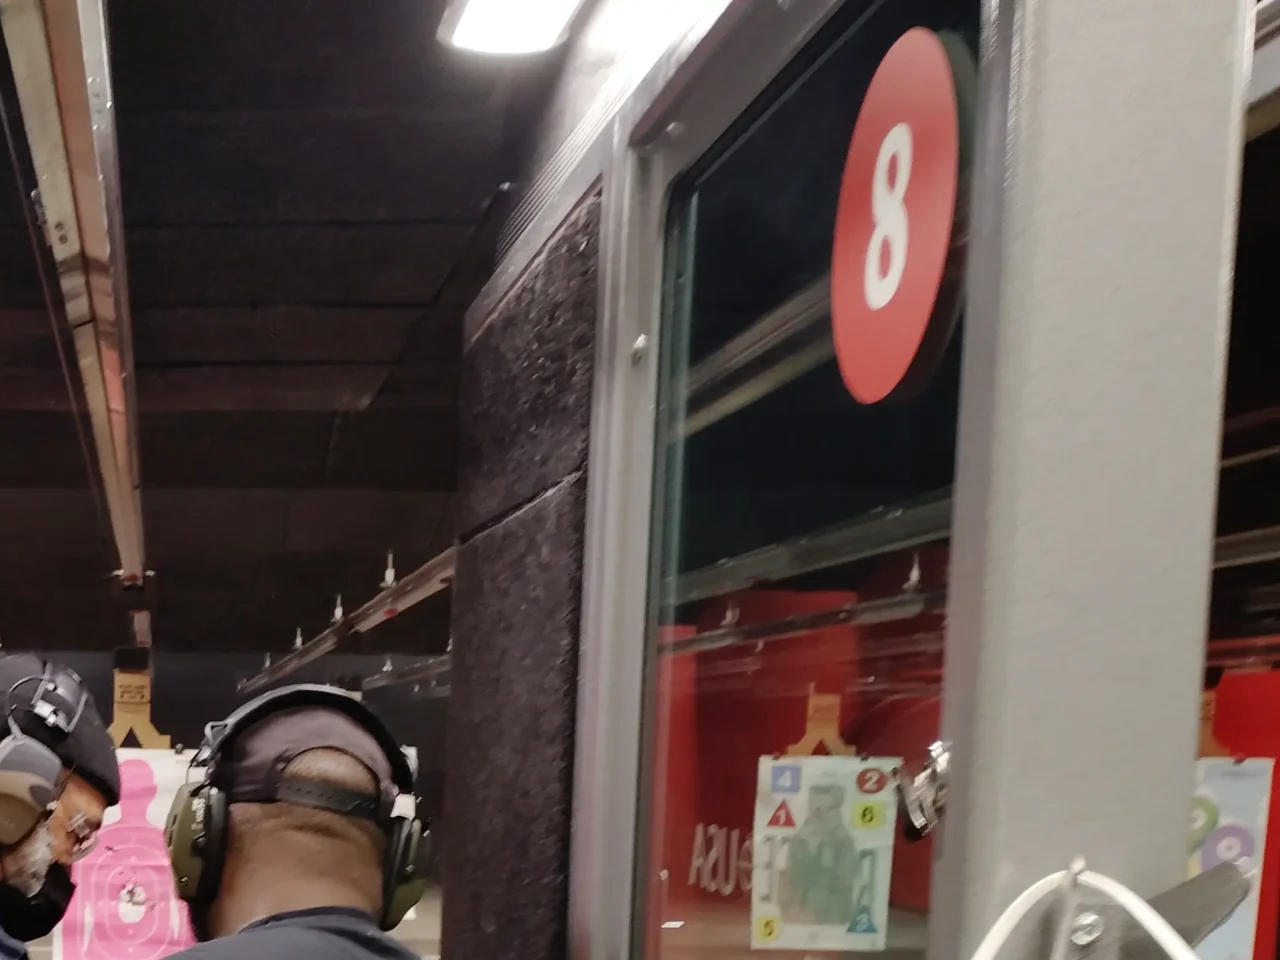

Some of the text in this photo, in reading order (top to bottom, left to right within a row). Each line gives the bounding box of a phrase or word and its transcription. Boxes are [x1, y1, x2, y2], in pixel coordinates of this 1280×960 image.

[864, 122, 913, 311] 8
[777, 770, 792, 788] 4
[863, 770, 880, 791] 2
[776, 807, 787, 825] 1
[861, 806, 874, 824] 6
